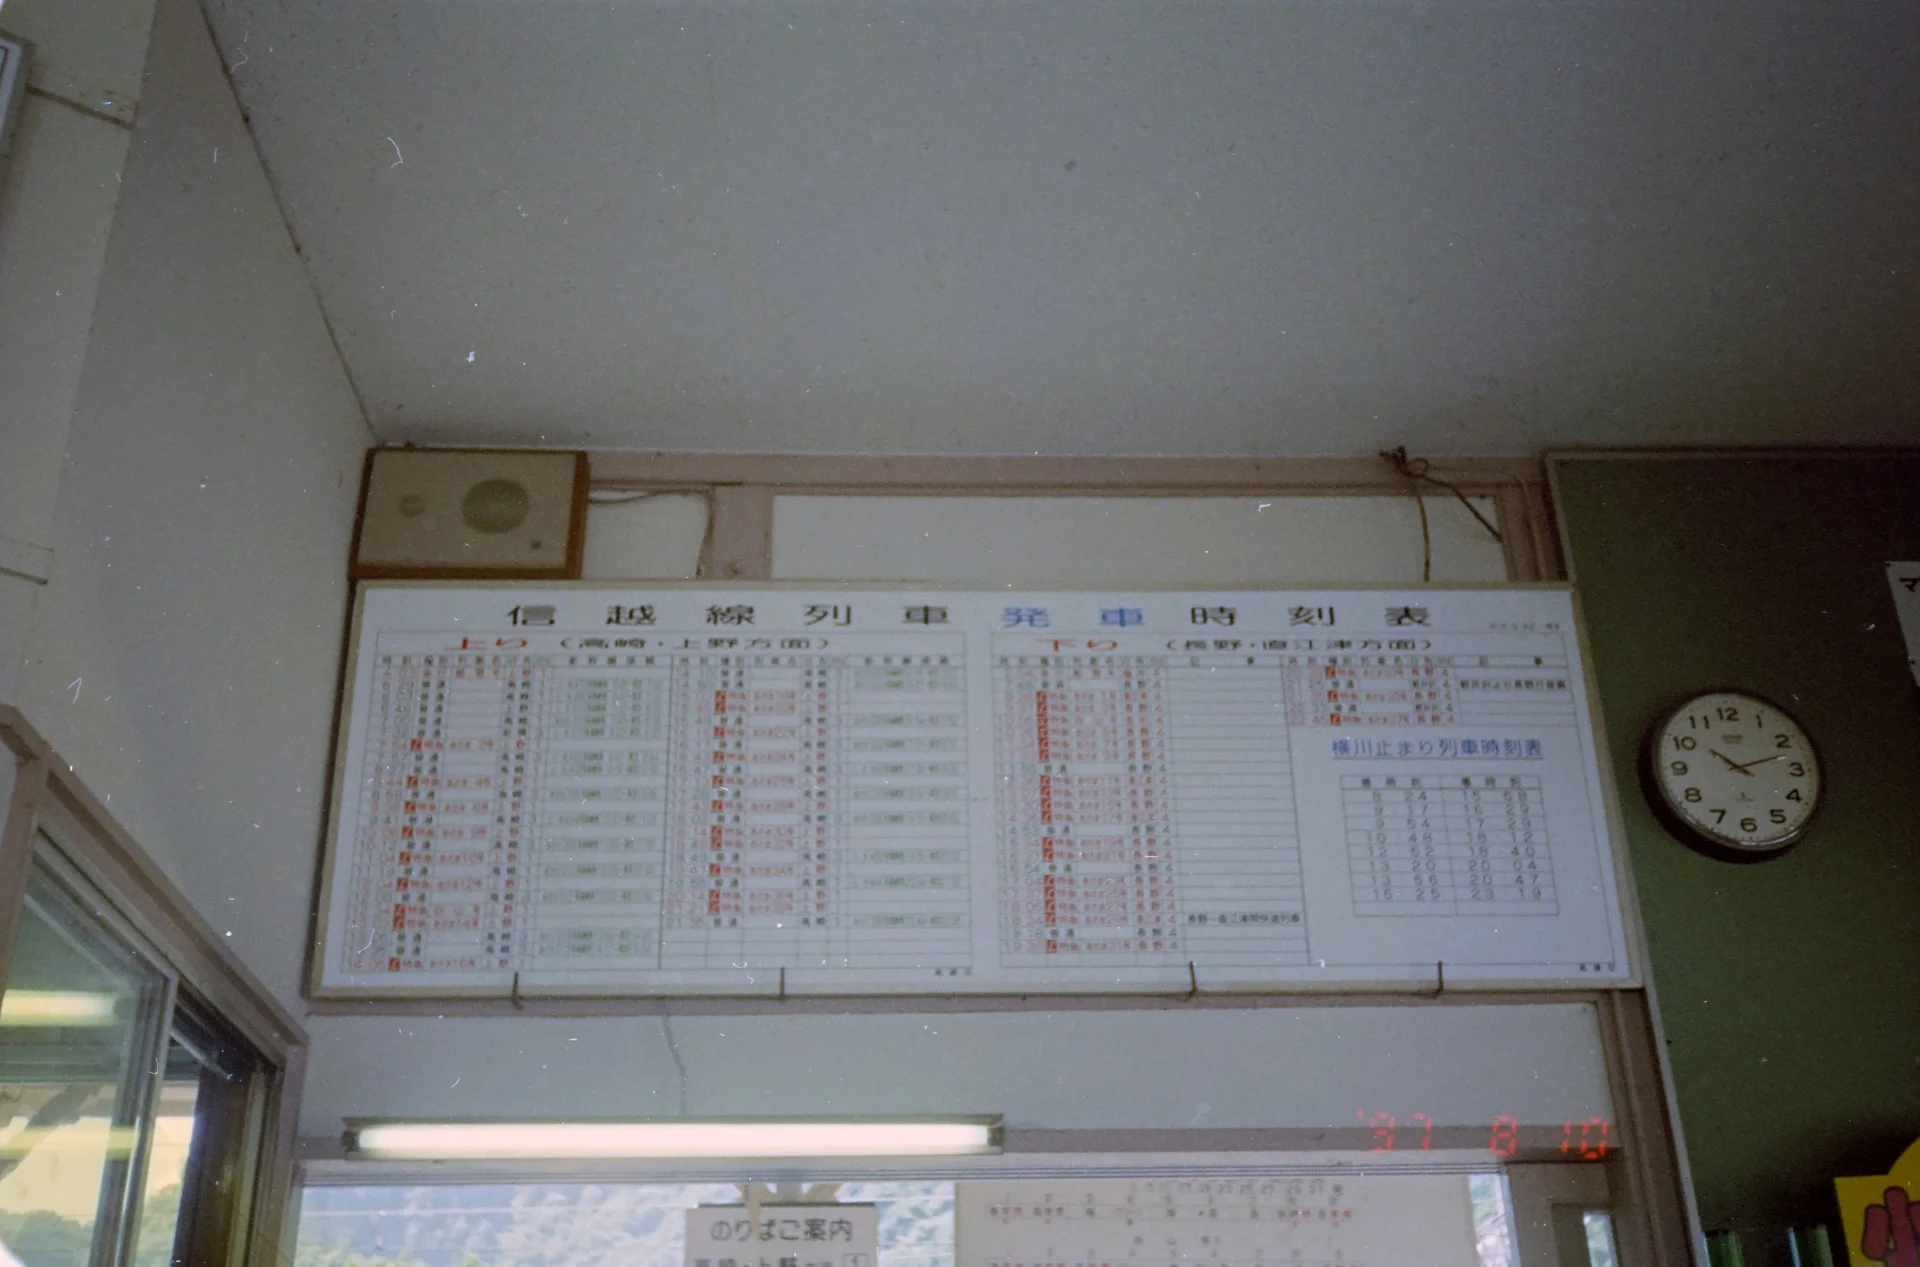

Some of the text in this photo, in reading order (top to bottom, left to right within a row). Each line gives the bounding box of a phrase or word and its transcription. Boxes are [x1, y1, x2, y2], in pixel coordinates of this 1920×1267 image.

[1716, 706, 1740, 722] 12
[1755, 714, 1763, 729] 1
[1689, 715, 1711, 730] 11
[1673, 735, 1697, 751] 10
[1774, 733, 1792, 749] 2
[1670, 760, 1689, 777] 9
[1788, 761, 1805, 778] 3
[1684, 787, 1702, 803] 8
[1785, 788, 1803, 803] 4
[1709, 808, 1728, 825] 7
[1769, 808, 1786, 824] 5
[1740, 817, 1758, 833] 6
